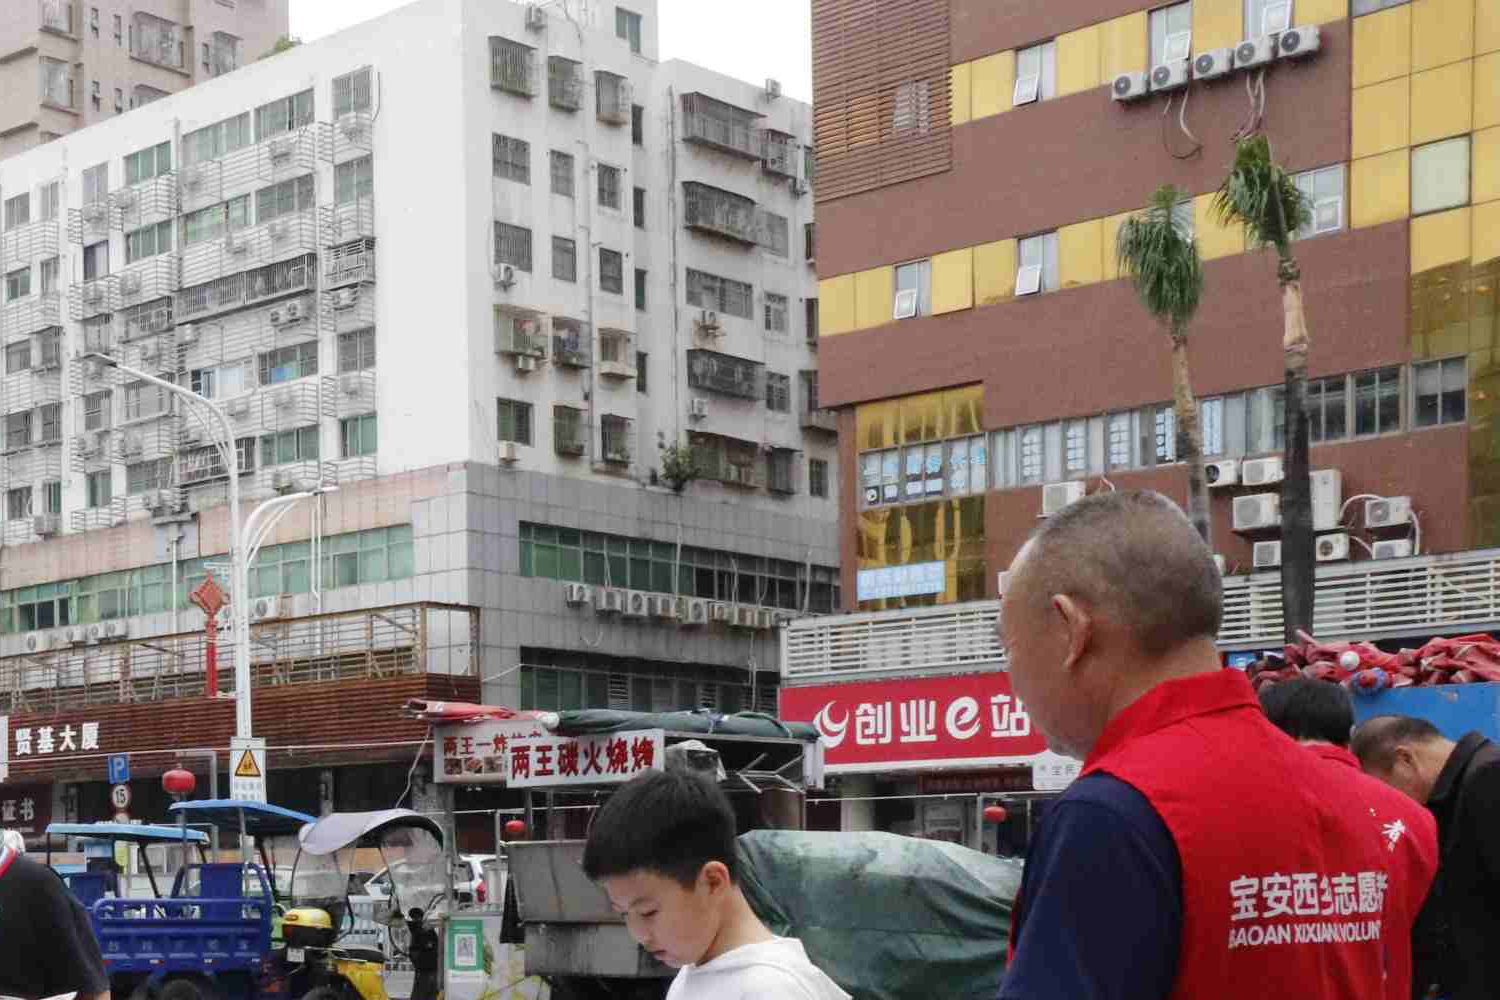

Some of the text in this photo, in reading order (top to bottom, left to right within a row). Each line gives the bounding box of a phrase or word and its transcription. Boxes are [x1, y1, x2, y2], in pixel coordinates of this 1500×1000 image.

[15, 722, 100, 756] 贤基大厦
[112, 757, 124, 778] P
[510, 736, 655, 780] 两王碳火烧烤
[115, 789, 126, 804] 15
